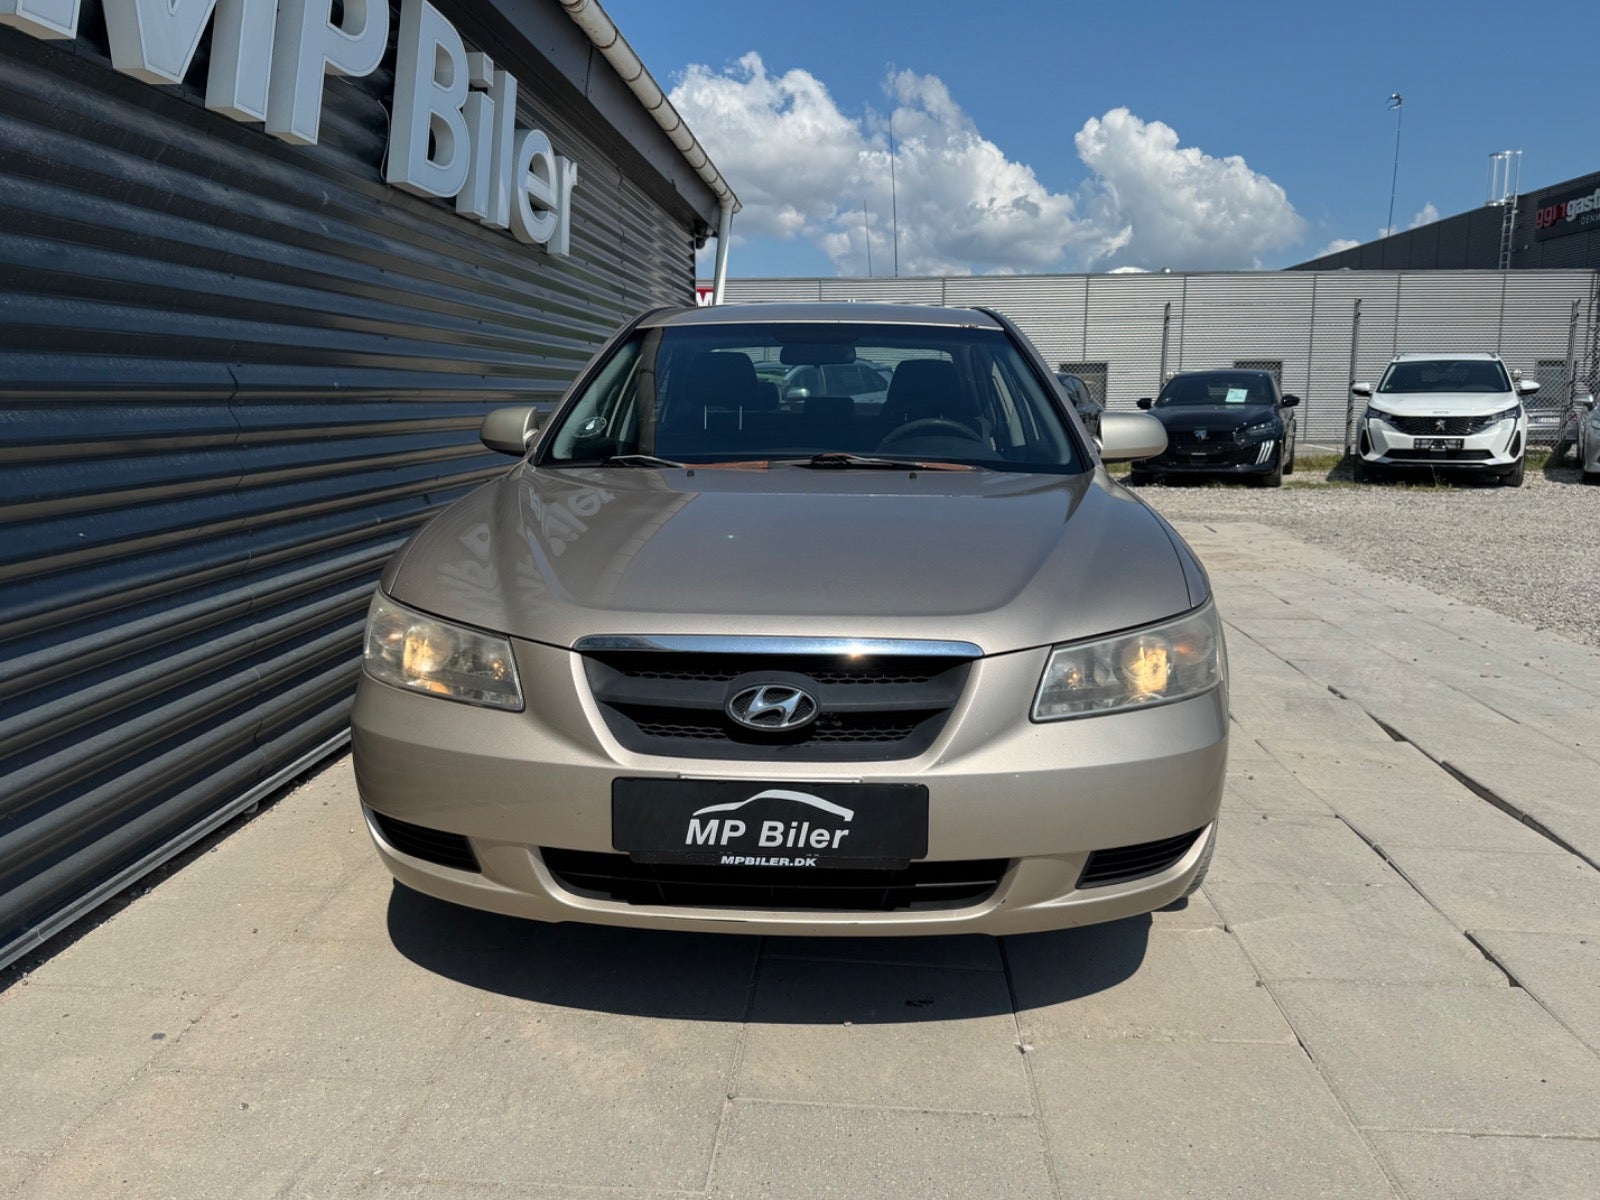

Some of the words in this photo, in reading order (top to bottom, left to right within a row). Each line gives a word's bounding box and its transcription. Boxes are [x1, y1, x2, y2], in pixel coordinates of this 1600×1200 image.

[386, 0, 577, 257] Biler
[685, 818, 746, 845] MP
[758, 820, 849, 849] Biler
[720, 855, 817, 867] MPBILER.DK
